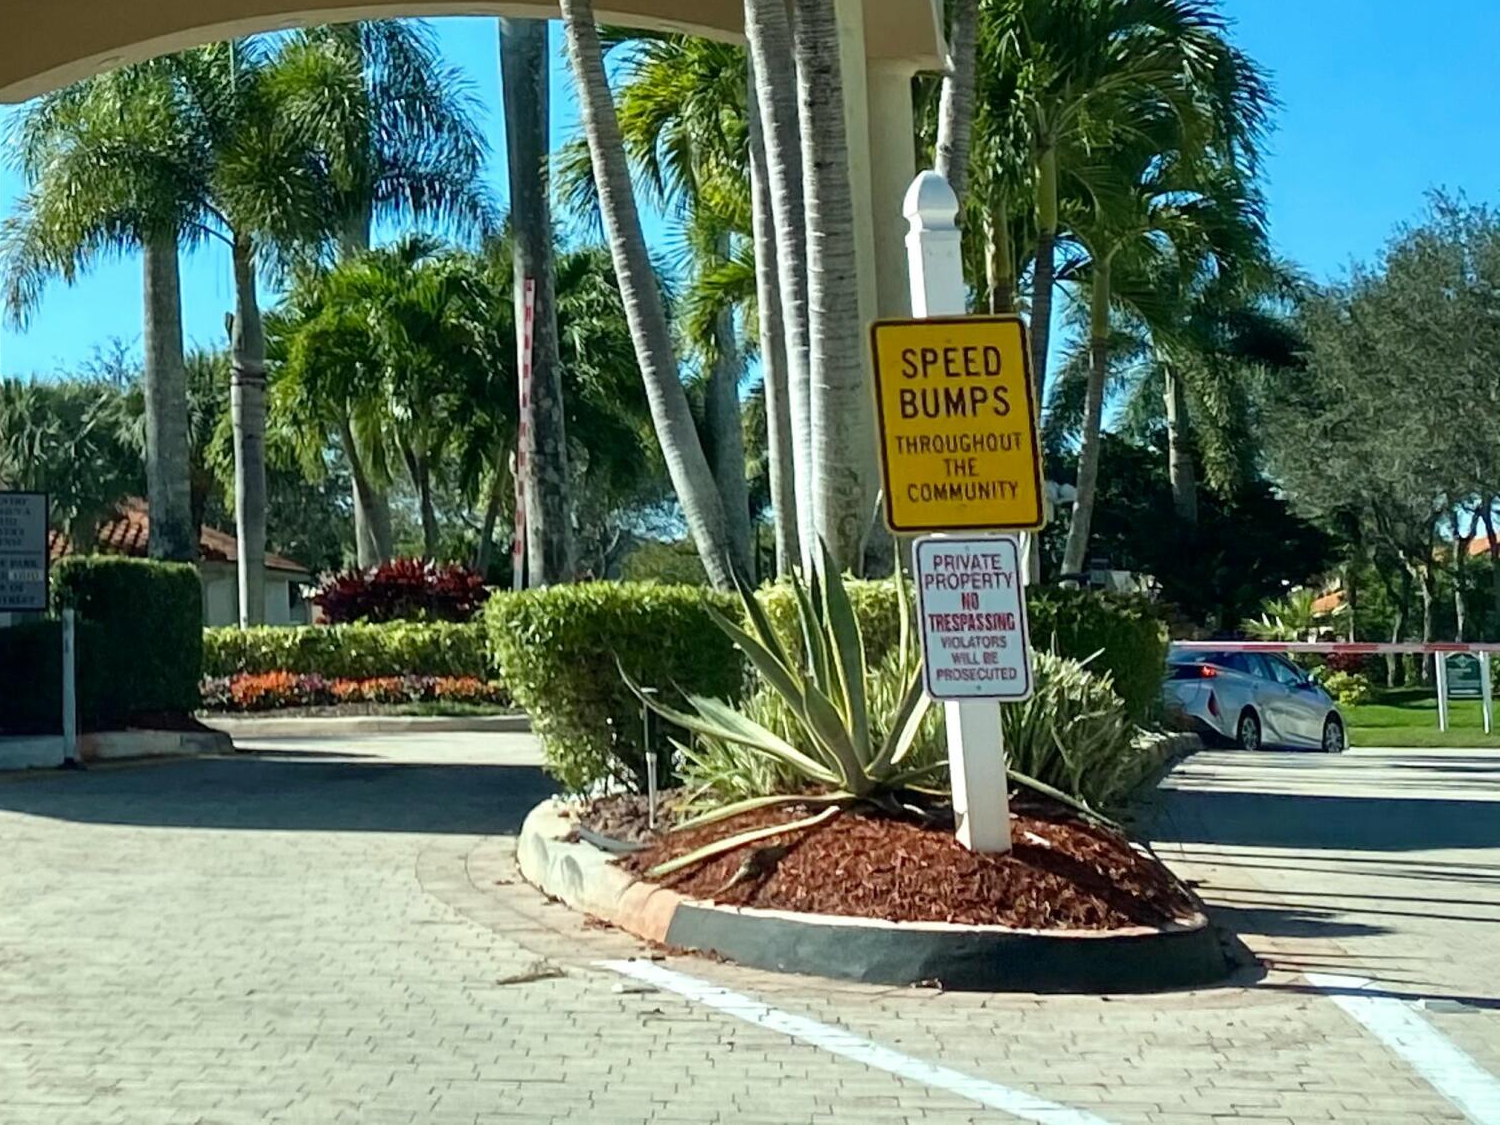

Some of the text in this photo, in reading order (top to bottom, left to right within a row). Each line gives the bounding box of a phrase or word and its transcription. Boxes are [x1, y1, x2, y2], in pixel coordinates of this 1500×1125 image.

[901, 345, 1002, 379] SPEED
[899, 385, 1011, 419] BUMPS
[895, 431, 1022, 454] THROUGHOUT
[943, 457, 980, 477] THE
[907, 480, 1019, 503] COMMUNITY
[933, 553, 1002, 572] PRIVATE
[924, 572, 1013, 590] PROPERTY
[961, 592, 980, 611] NO
[928, 613, 1015, 632] TRESPASSING
[940, 635, 1007, 649] VIOLATORS
[951, 651, 999, 665] WILL BE
[936, 667, 1018, 682] PROSECUTED
